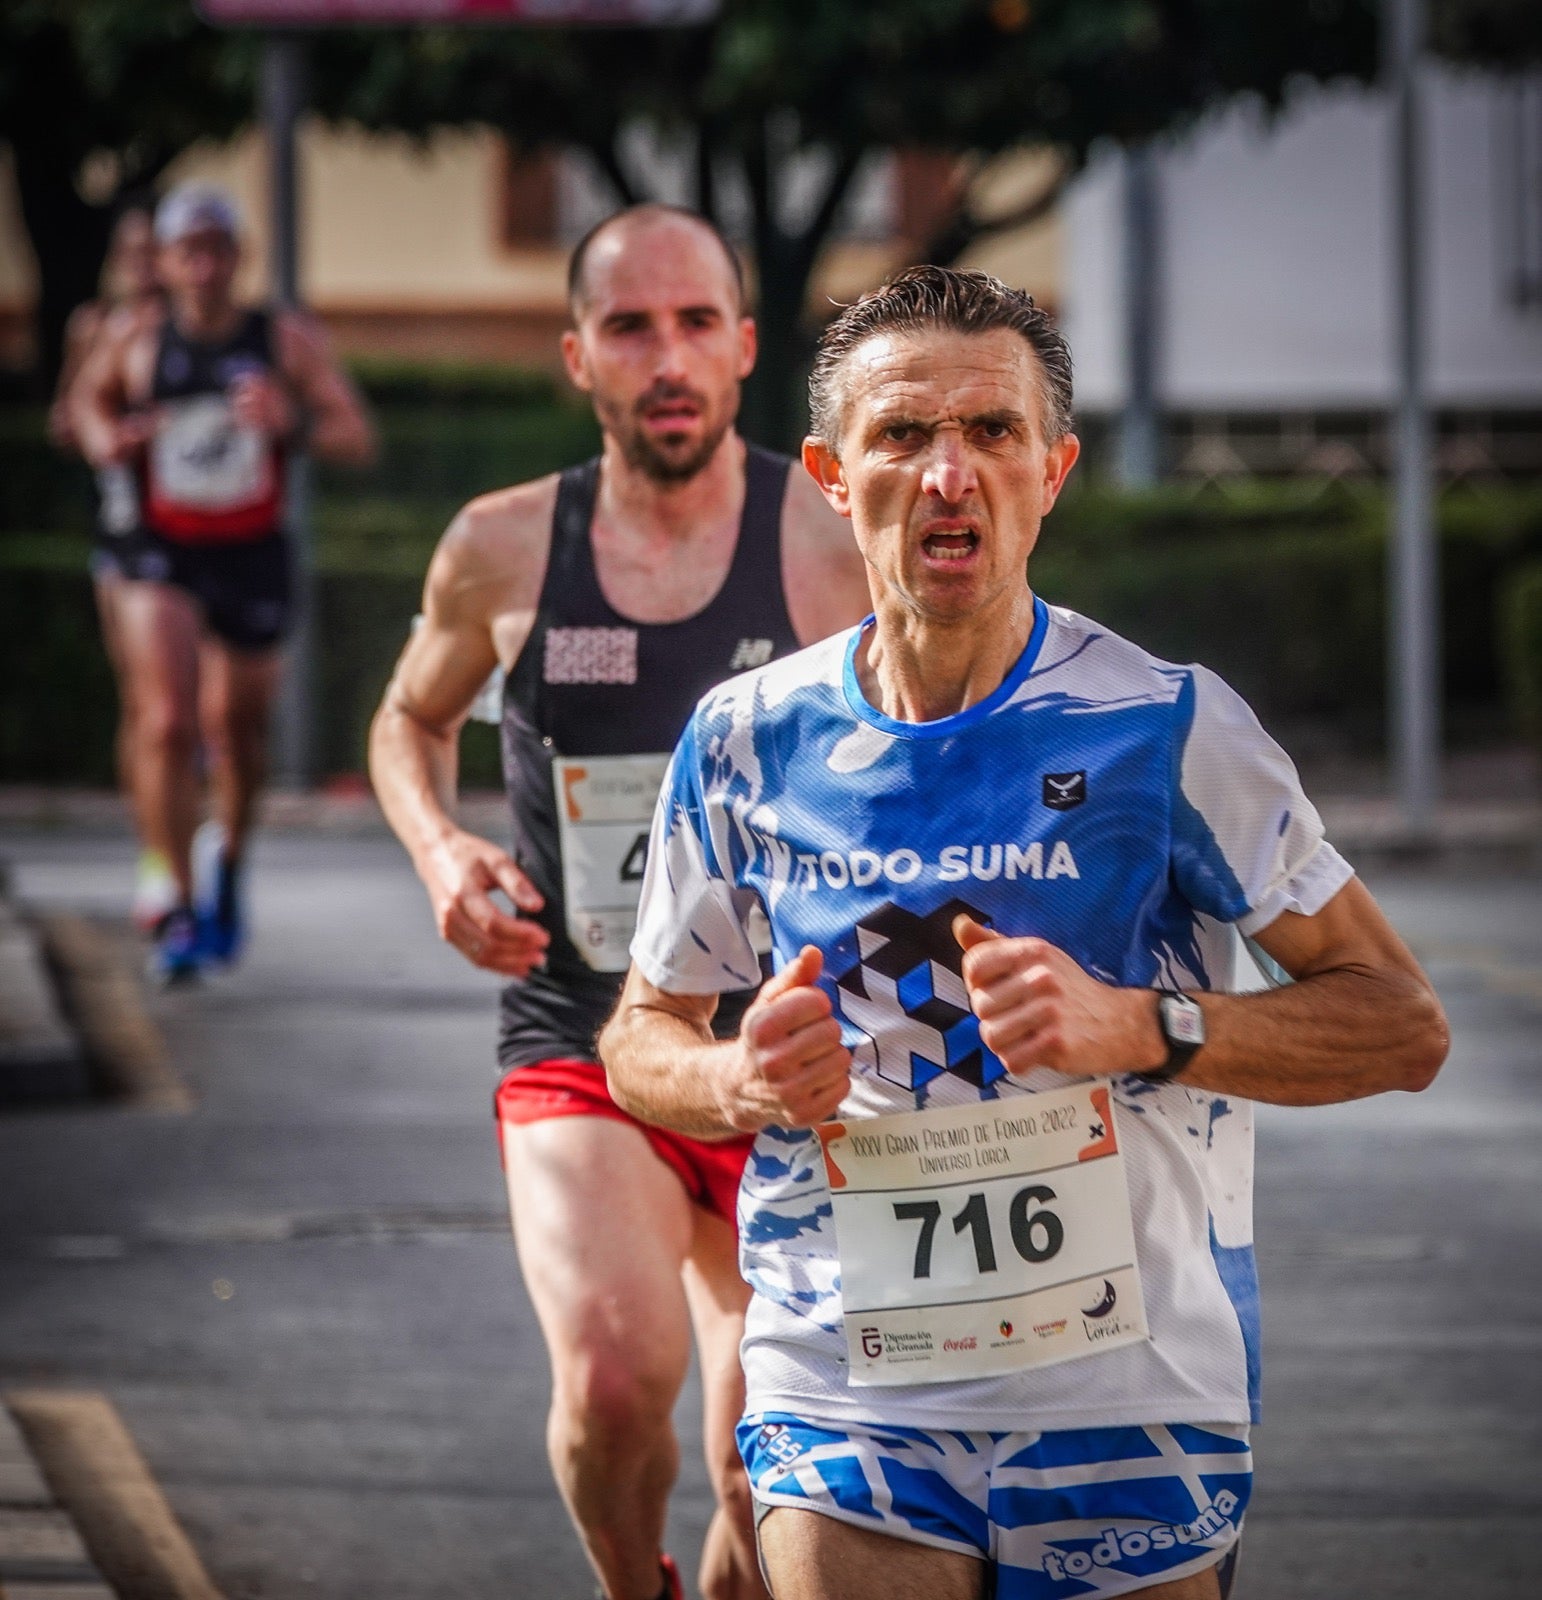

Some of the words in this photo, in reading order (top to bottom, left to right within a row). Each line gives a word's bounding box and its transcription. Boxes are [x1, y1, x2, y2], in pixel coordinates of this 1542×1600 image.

[796, 848, 923, 892] TODO
[936, 840, 1081, 882] SUMA
[851, 1135, 883, 1158] XXXV
[886, 1133, 919, 1156] GRAN
[922, 1127, 971, 1149] PREMIO
[974, 1124, 990, 1144] DE
[994, 1117, 1036, 1141] FONDO
[1040, 1105, 1078, 1134] 2022
[918, 1153, 972, 1175] UNIVERSO
[976, 1146, 1011, 1167] LORCA
[892, 1185, 1064, 1279] 716
[897, 1340, 934, 1353] Granada
[1041, 1489, 1240, 1582] todosuma
